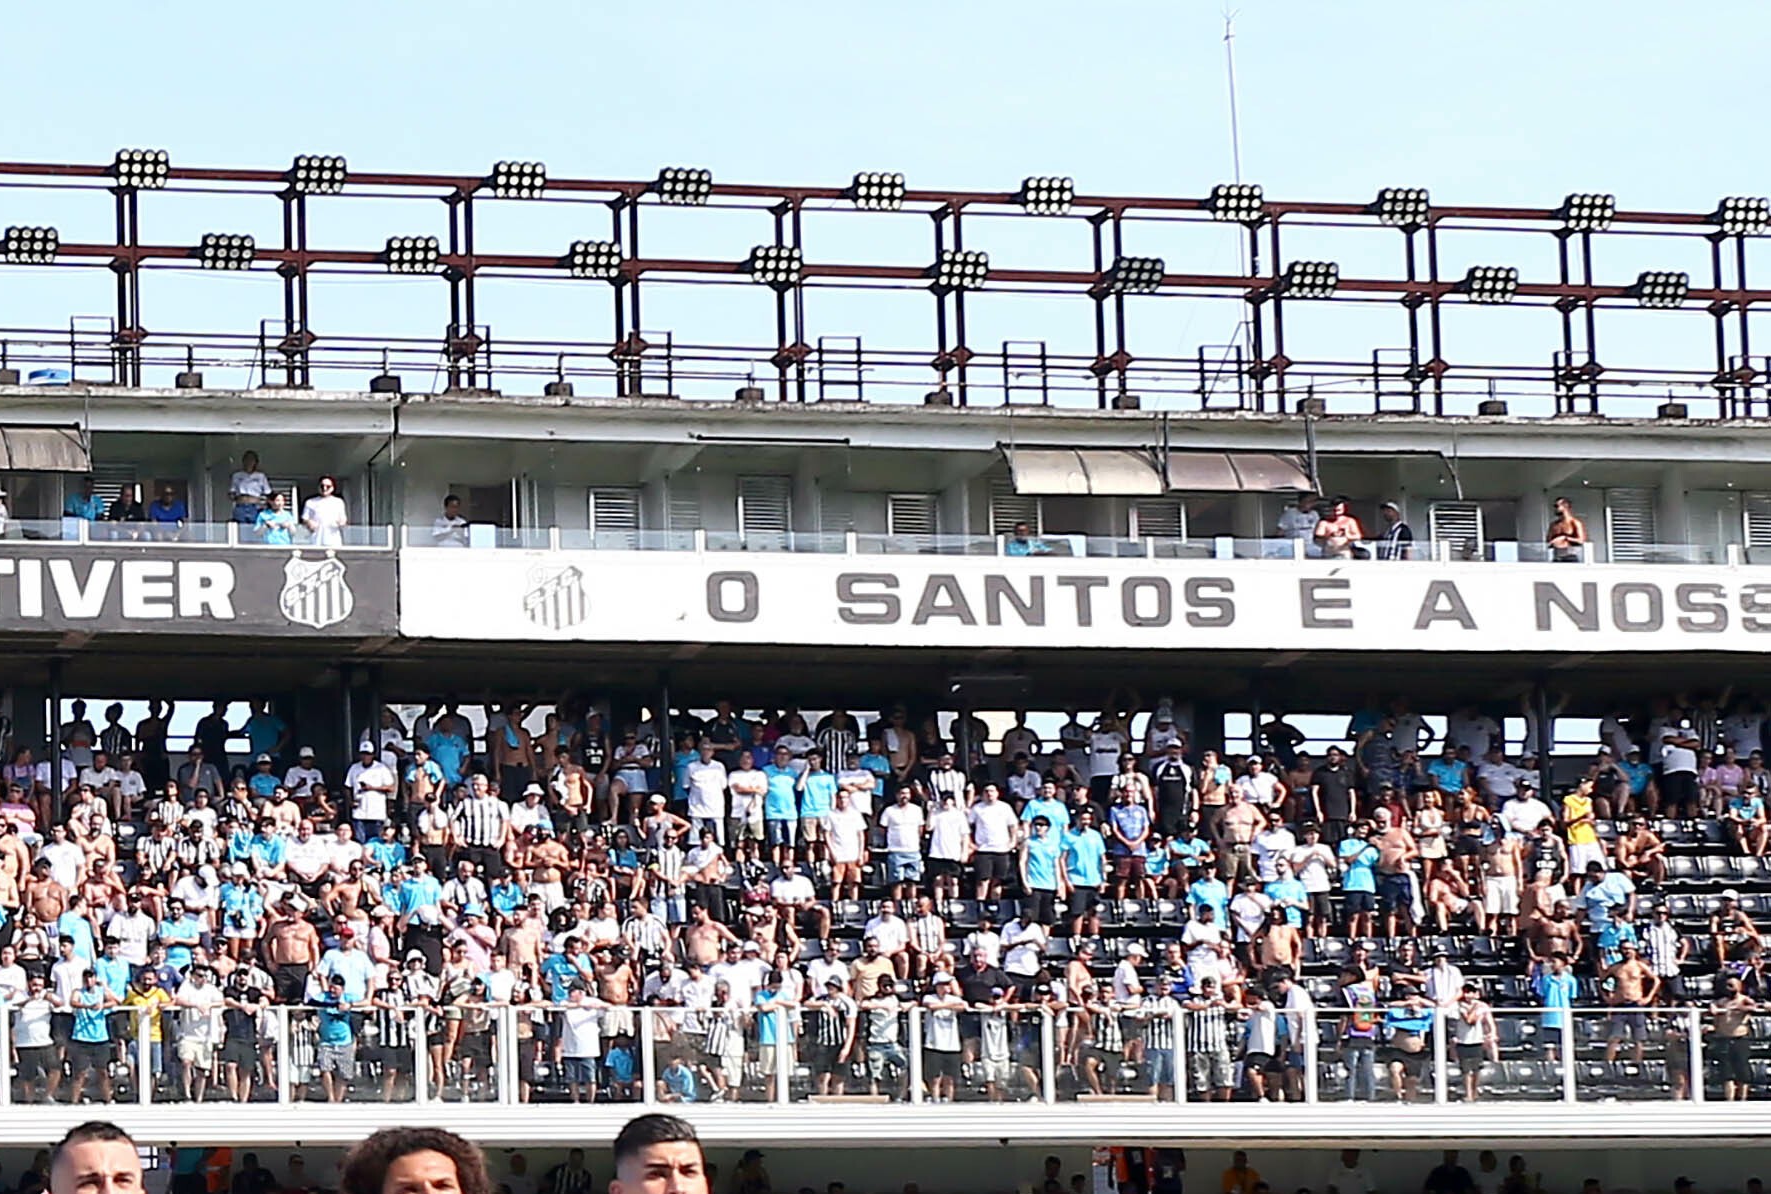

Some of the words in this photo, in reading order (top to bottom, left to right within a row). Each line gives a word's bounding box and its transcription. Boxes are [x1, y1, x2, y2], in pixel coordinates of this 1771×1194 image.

[705, 570, 760, 624] O
[835, 572, 1236, 628] SANTOS
[1298, 567, 1355, 630] É
[1413, 579, 1479, 631] A
